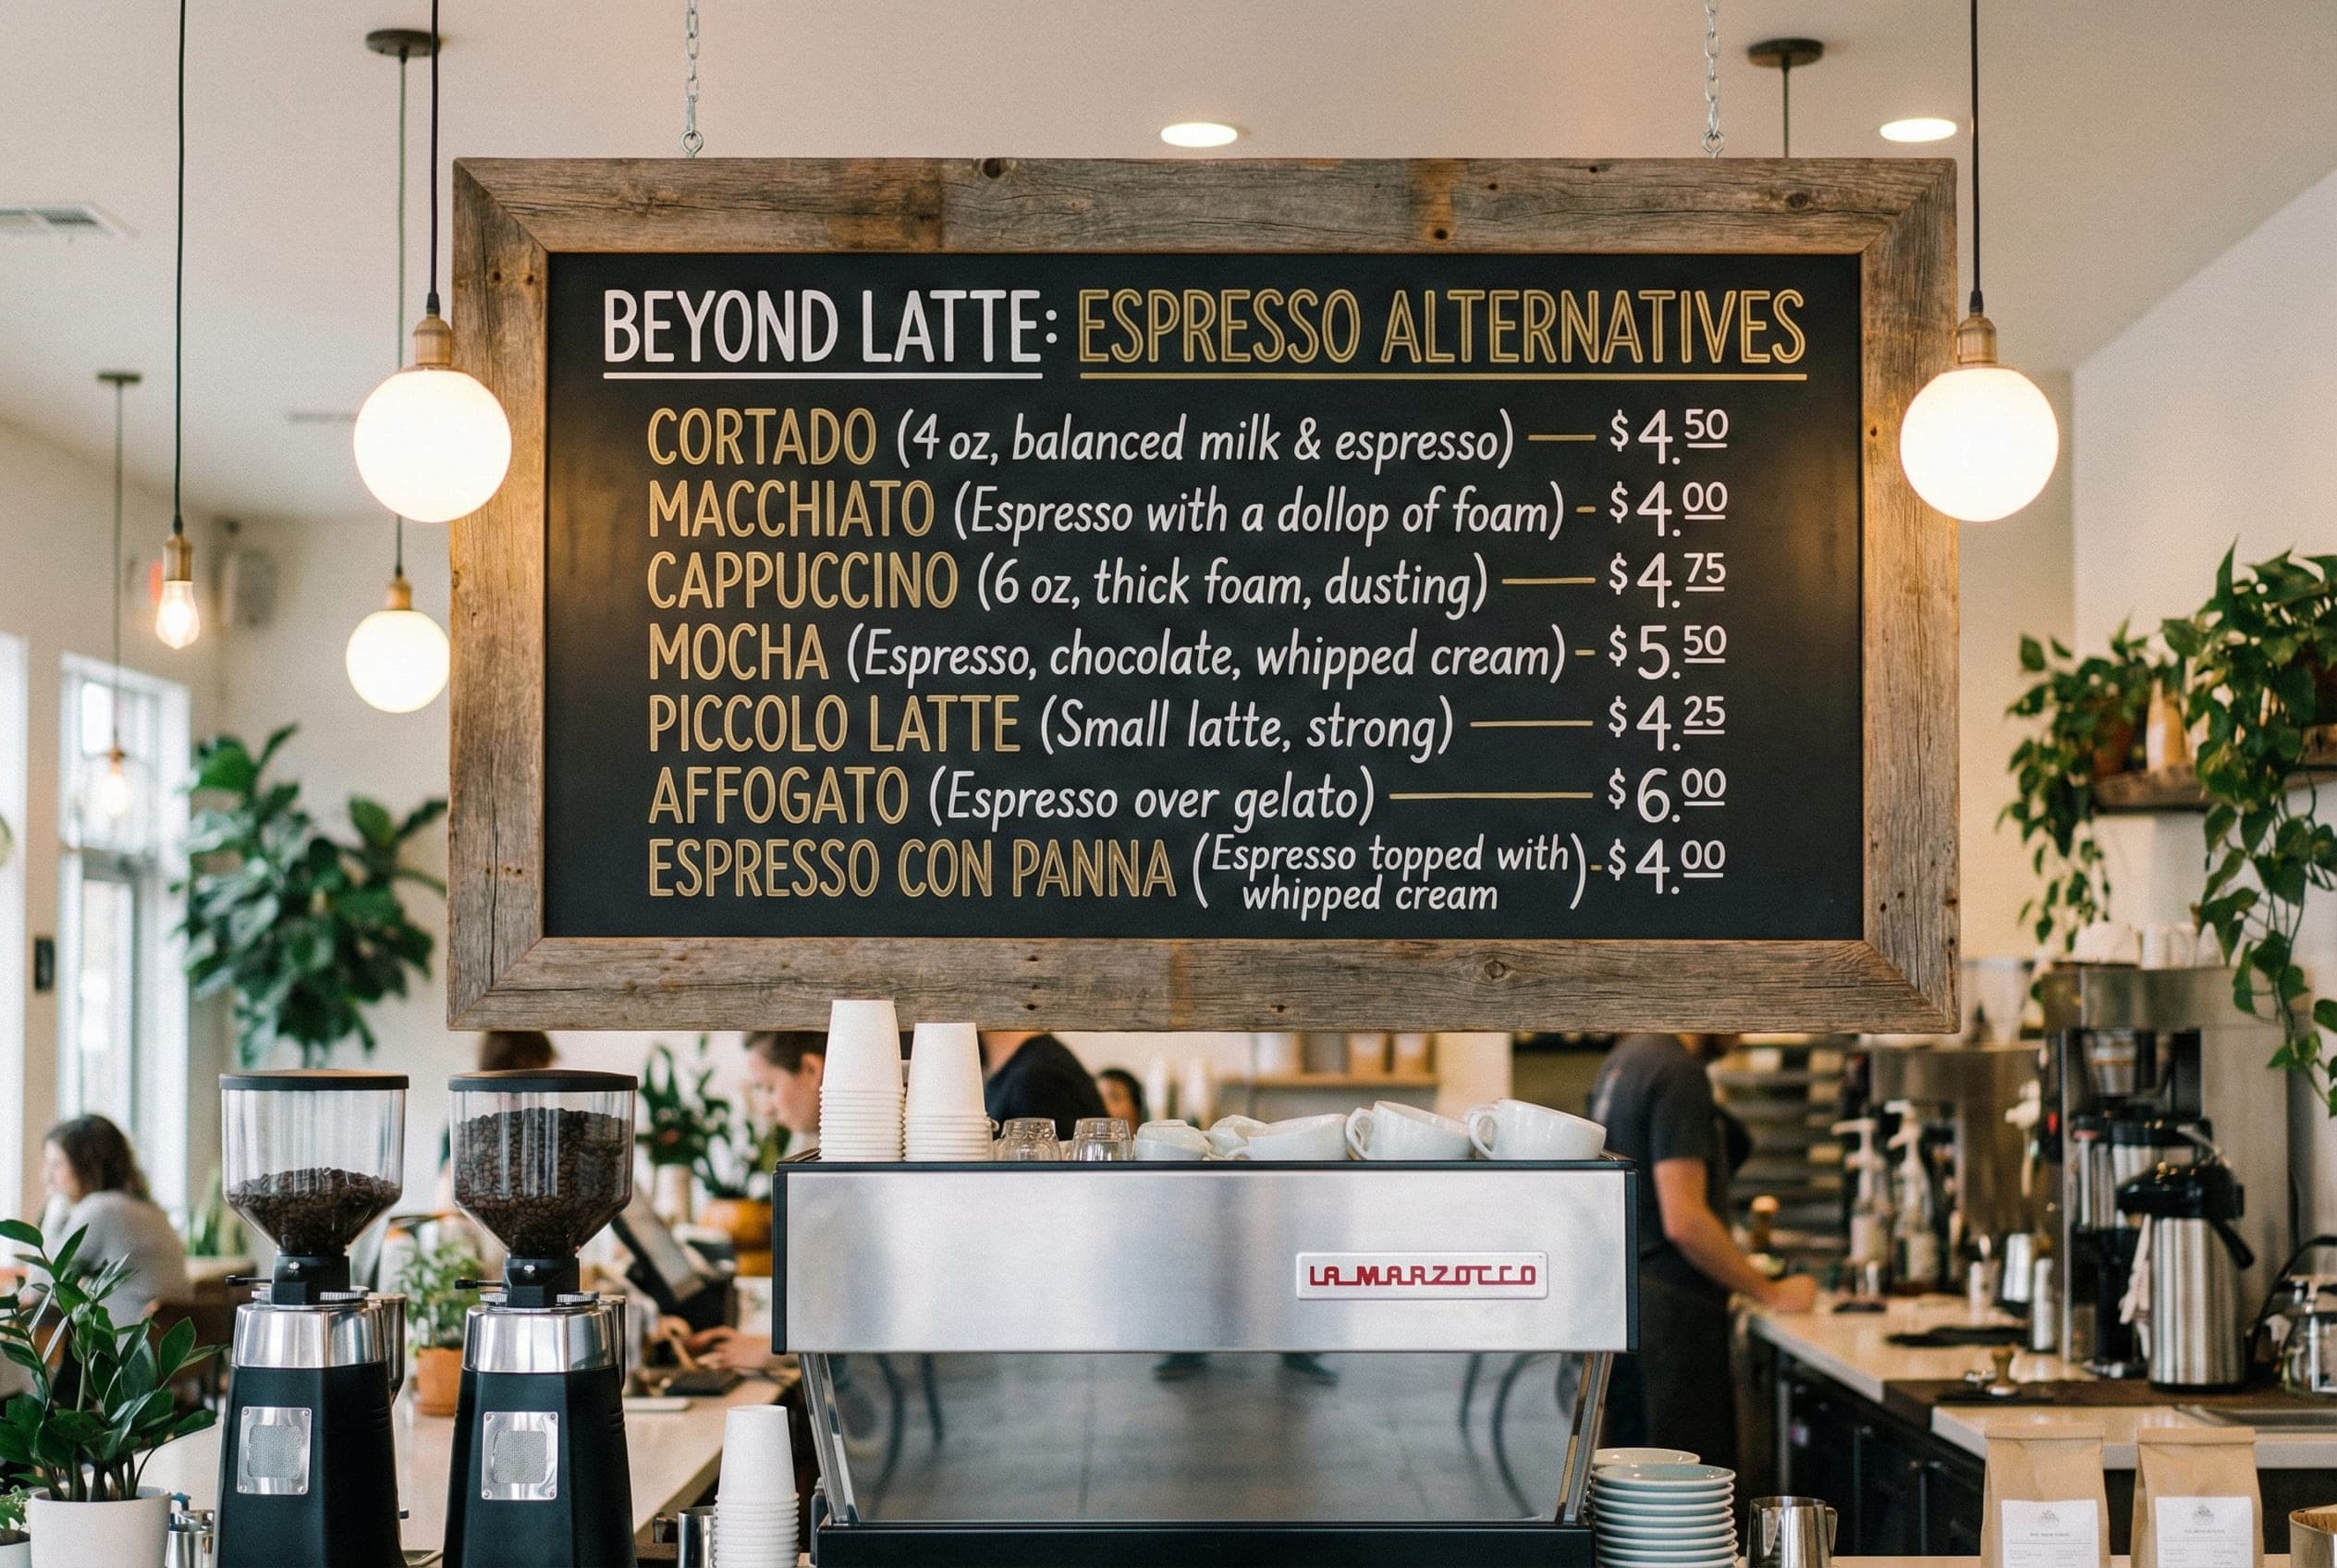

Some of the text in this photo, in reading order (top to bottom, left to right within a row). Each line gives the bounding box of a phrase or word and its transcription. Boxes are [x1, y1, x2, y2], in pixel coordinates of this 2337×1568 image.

[604, 288, 1806, 364] BEYOND LATTE: ESPRESSO ALTERNATIVES
[647, 407, 1730, 476] CORTADO (4 oz, balanced milk & espresso) $4.50
[648, 479, 1729, 548] MACCHIATO (Espresso with a dollop of foam) $4.00
[646, 550, 1727, 621] CAPPUCCINO (6 oz, thick foam, dusting) $4.75
[649, 622, 1728, 691] MOCHA (Espresso, chocolate, whipped cream) $5.50
[649, 693, 1726, 764] PICCOLO LATTE (Small latte, strong) $4.25
[648, 765, 1727, 834] AFFOGATO (Espresso over gelato) $6.00
[649, 838, 880, 898] ESPRESSO
[898, 838, 993, 898] CON
[1012, 839, 1177, 898] PANNA
[1368, 833, 1485, 883] topped
[1608, 838, 1726, 895] $4.00
[1242, 873, 1383, 922] whipped
[1309, 1265, 1340, 1286] LA
